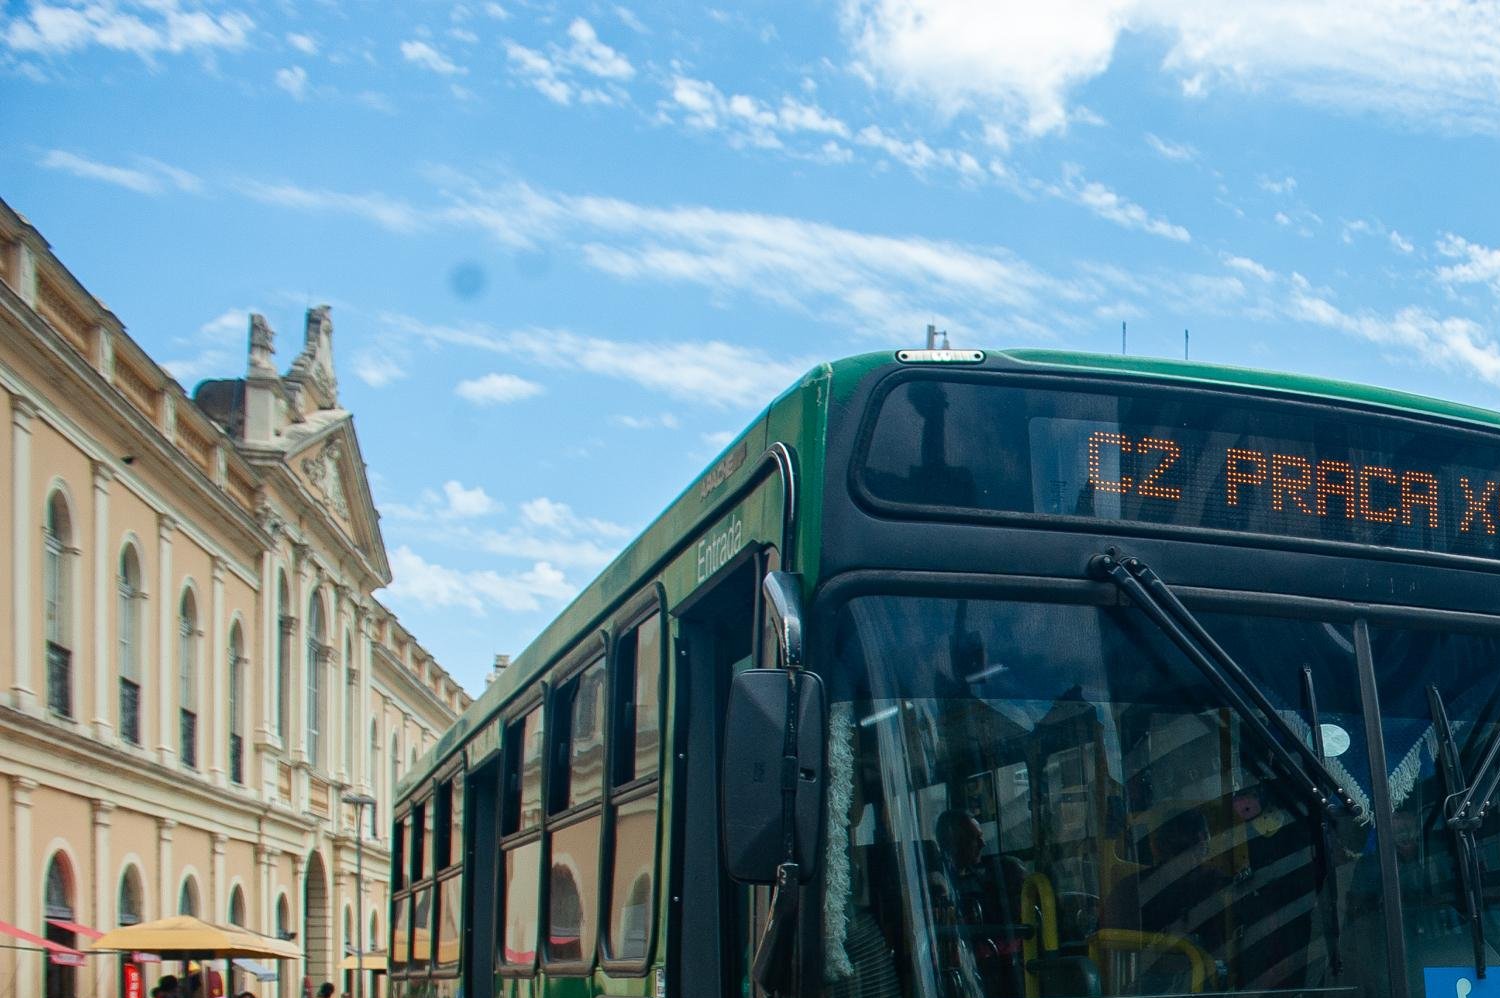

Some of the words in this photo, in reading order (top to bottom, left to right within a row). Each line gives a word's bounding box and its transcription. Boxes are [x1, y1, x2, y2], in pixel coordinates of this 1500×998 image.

[1088, 431, 1181, 500] C2
[1226, 448, 1438, 528] PRACA
[697, 514, 742, 583] Entrada
